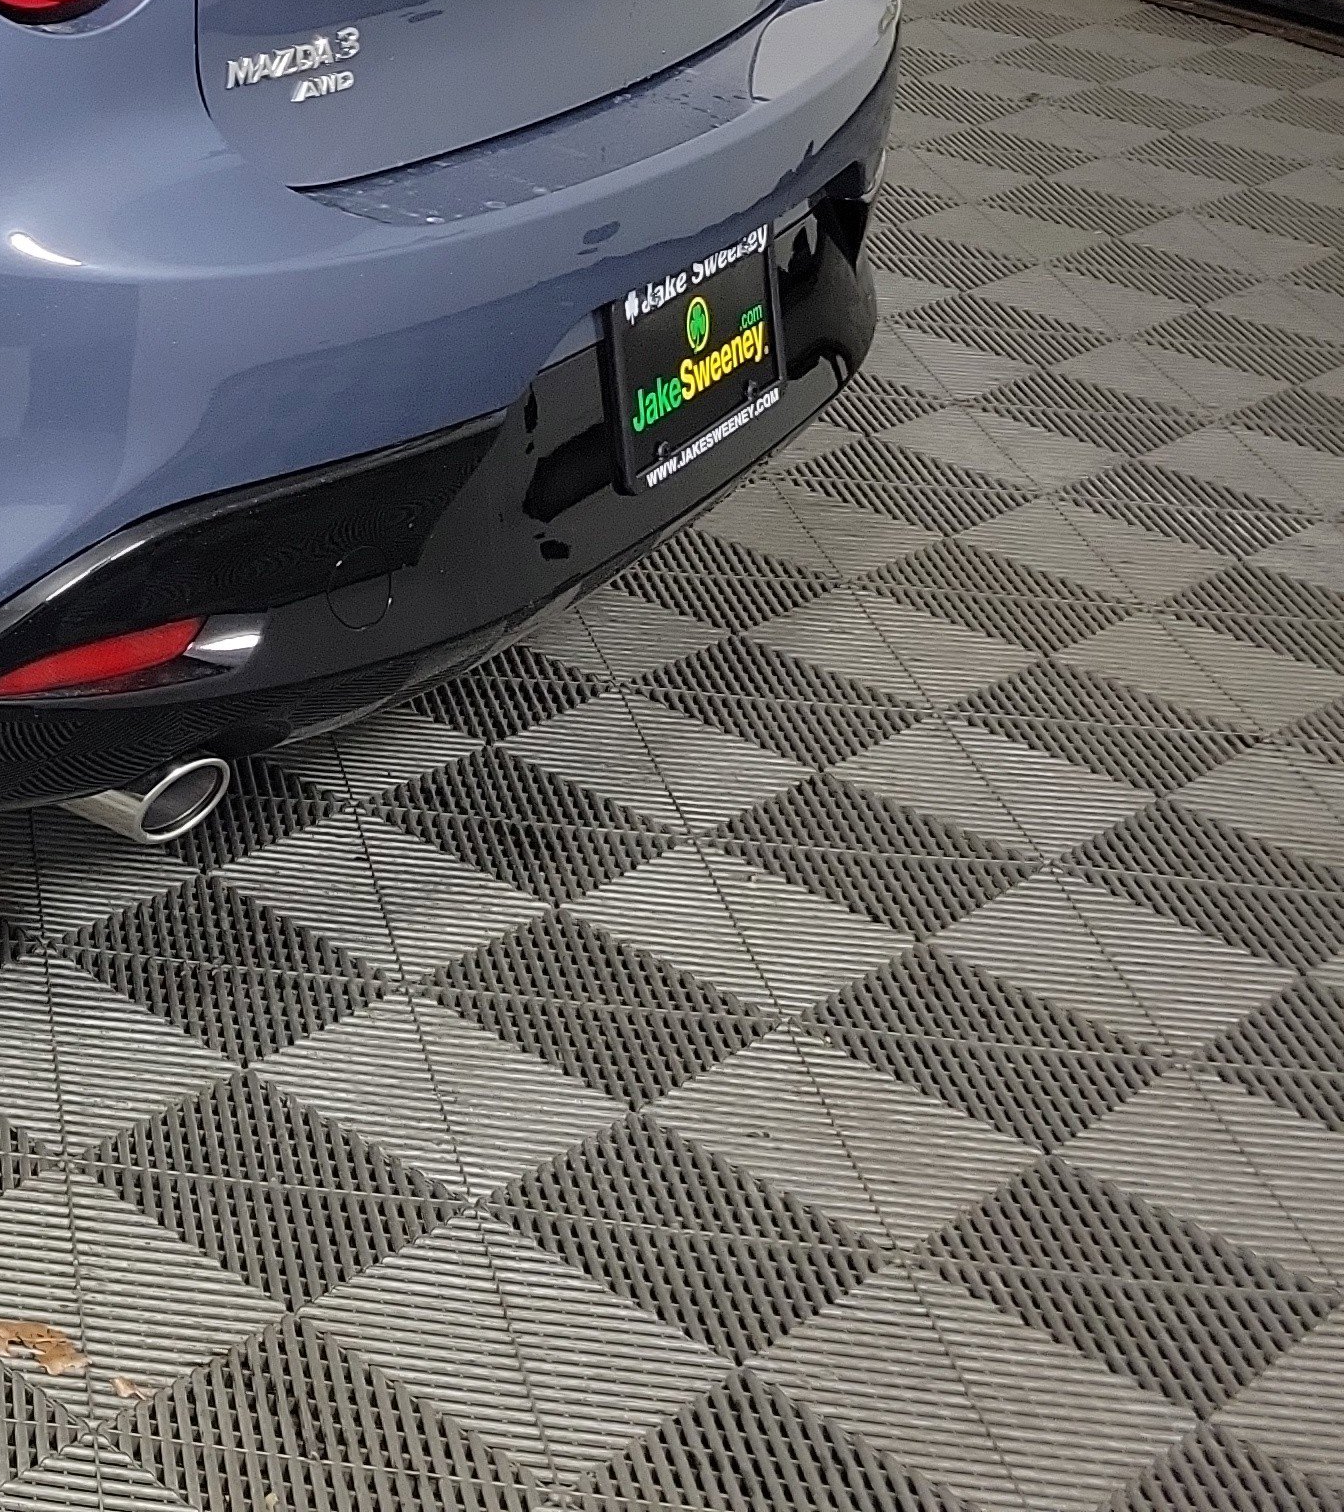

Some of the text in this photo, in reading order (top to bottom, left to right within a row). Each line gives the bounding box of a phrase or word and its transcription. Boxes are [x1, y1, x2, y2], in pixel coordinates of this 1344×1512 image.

[290, 71, 355, 103] AWD
[641, 271, 687, 314] Jake
[646, 387, 780, 488] WWW.JAKESWEENEY.COM
